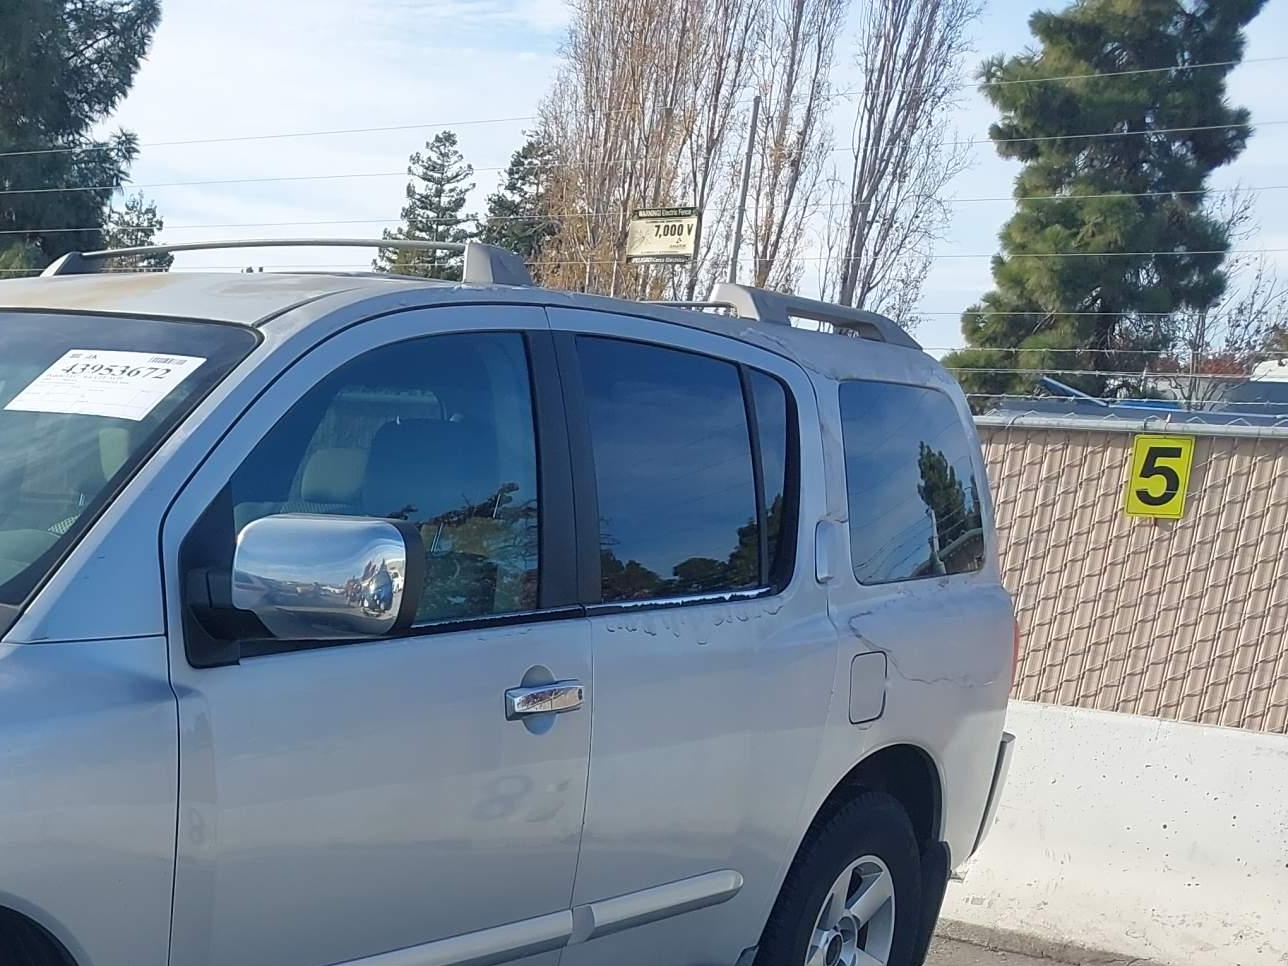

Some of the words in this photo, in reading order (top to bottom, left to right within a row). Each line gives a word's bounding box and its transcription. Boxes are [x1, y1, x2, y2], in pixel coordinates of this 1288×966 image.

[654, 223, 684, 238] 7,000
[687, 223, 694, 235] V
[61, 362, 171, 379] 43953672
[1135, 446, 1183, 506] 5
